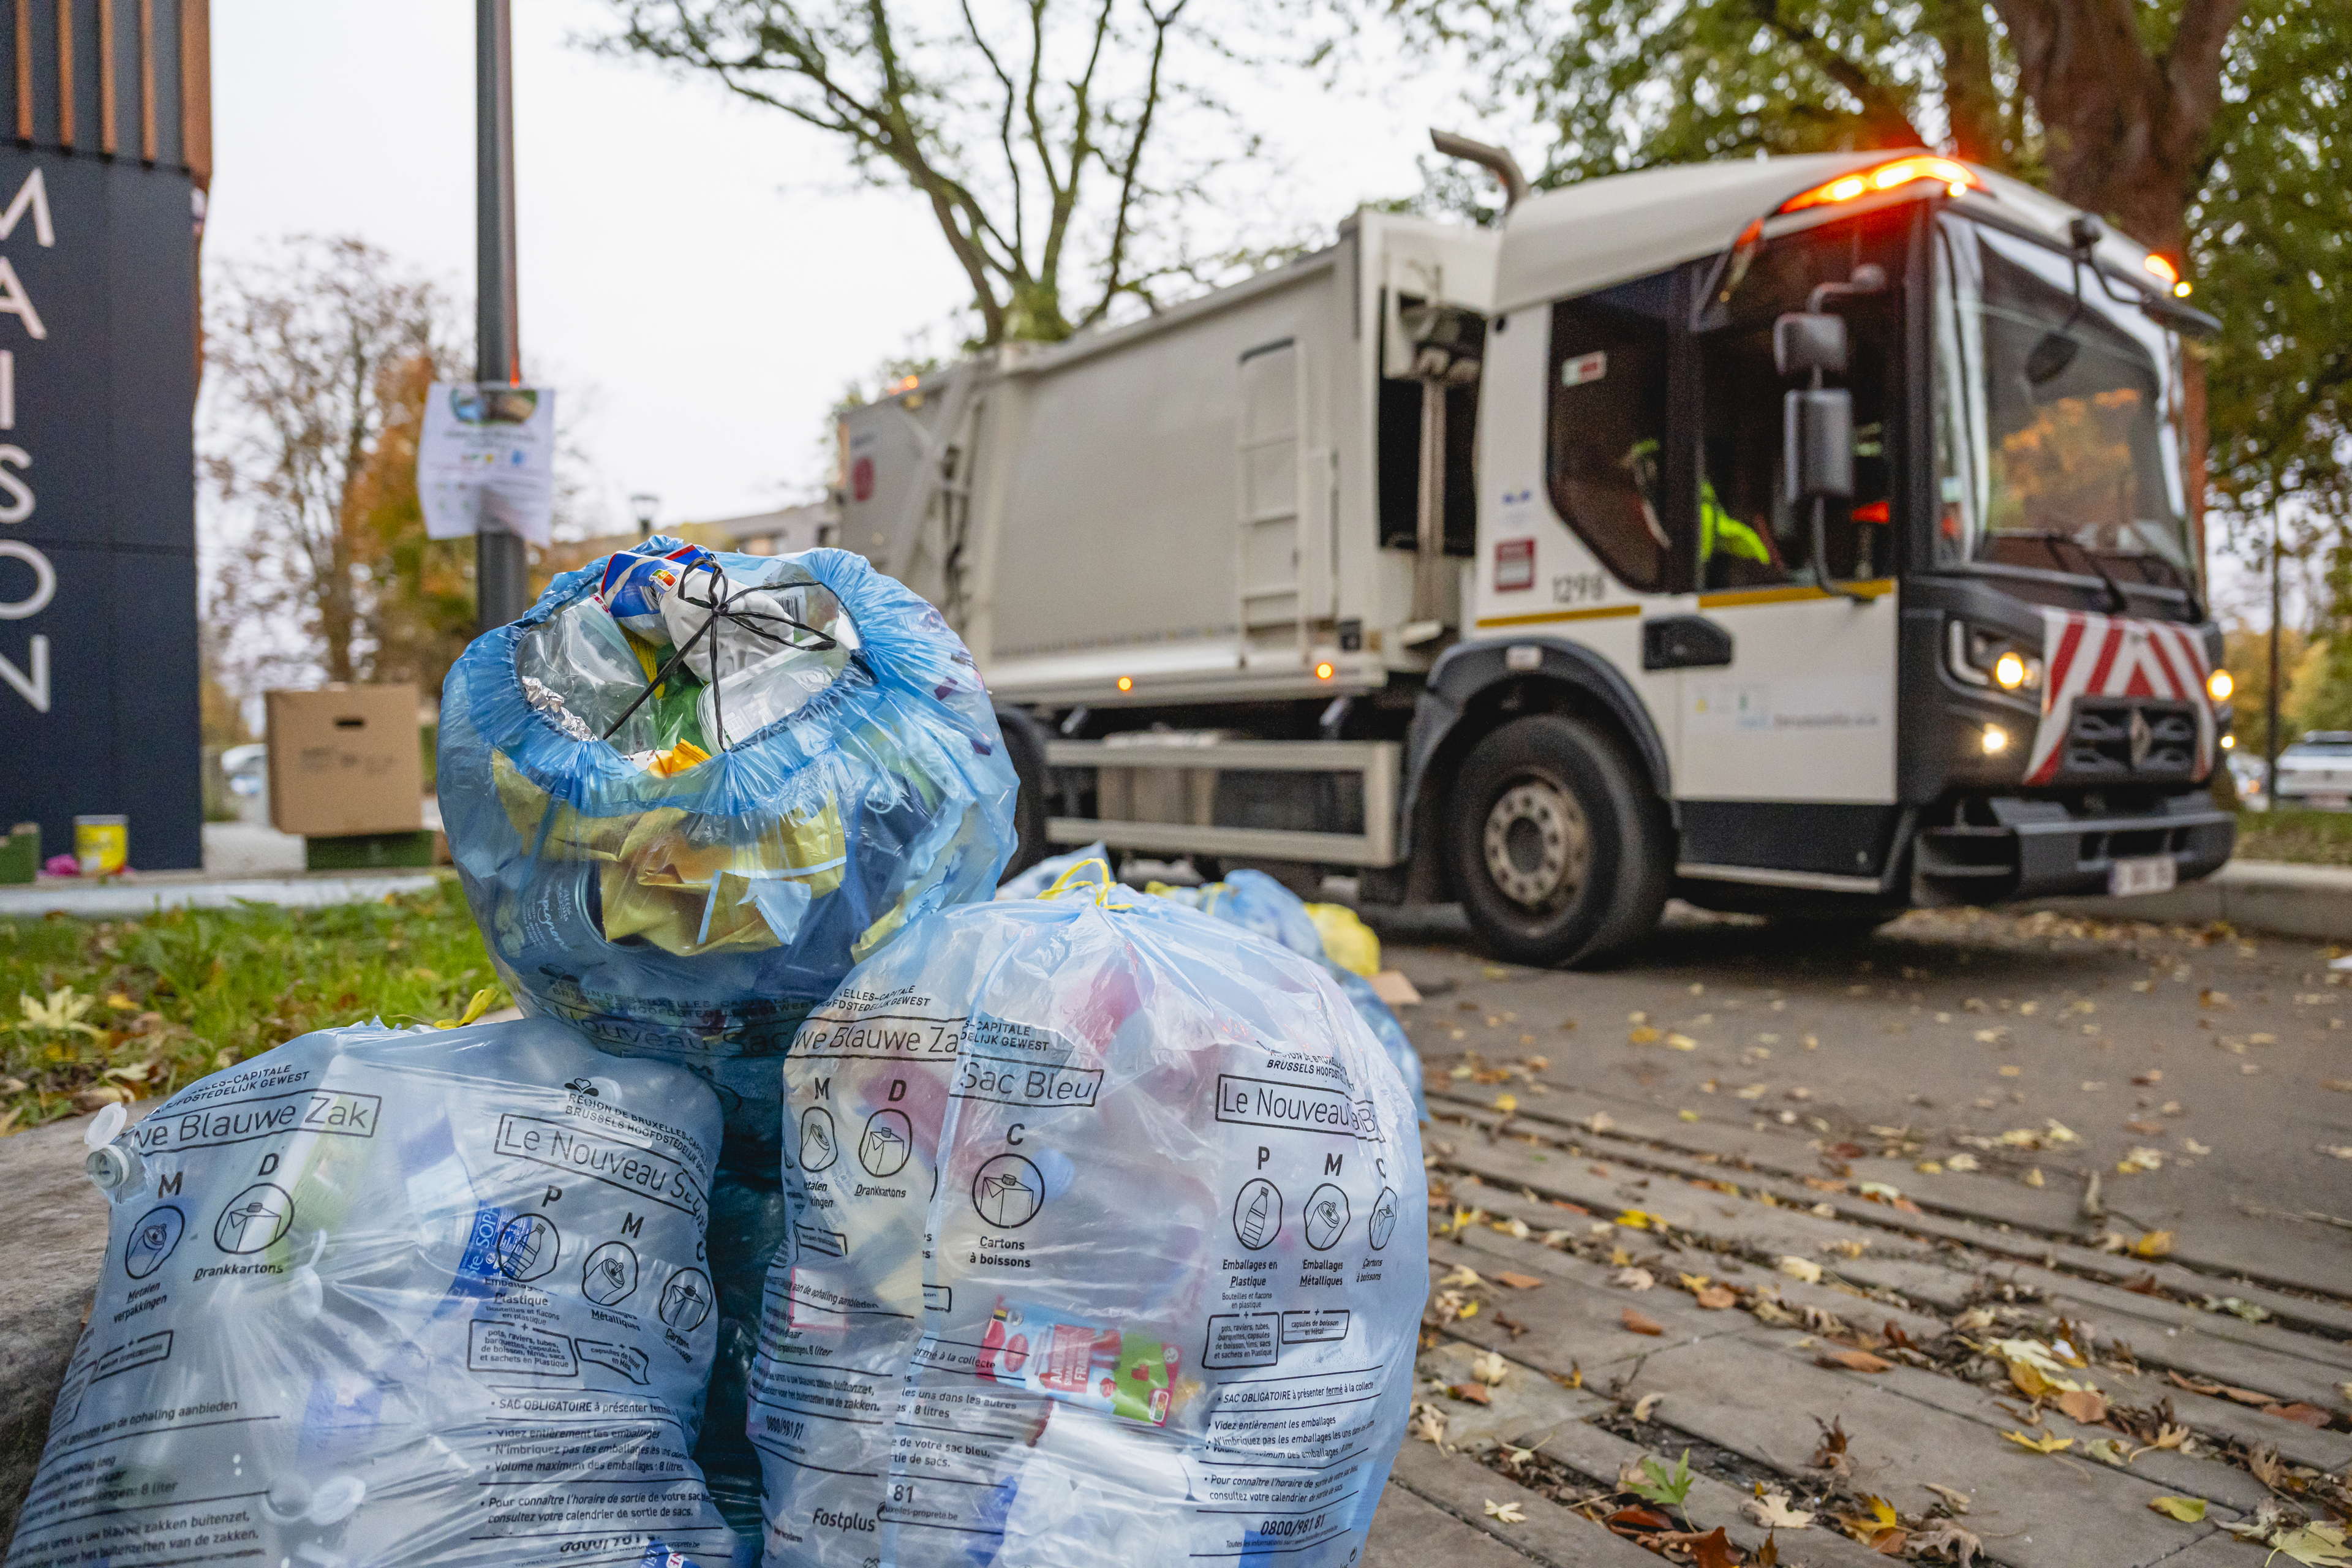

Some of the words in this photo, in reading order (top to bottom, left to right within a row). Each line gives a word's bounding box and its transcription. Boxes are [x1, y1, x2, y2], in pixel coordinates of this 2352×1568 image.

[840, 985, 916, 1001] ELLES-CAPITALE
[891, 996, 930, 1006] GEWEST
[829, 1025, 921, 1051] Blauwe
[928, 1027, 958, 1053] Za
[1002, 1038, 1050, 1051] GEWEST
[1267, 1059, 1314, 1074] BRUSSELS
[260, 1071, 310, 1088] GEWEST
[960, 1061, 1015, 1094] Sac
[1025, 1071, 1093, 1099] Bleu
[814, 1077, 829, 1101] M
[888, 1079, 907, 1102] D
[614, 1107, 629, 1118] DE
[1223, 1083, 1248, 1114] Le
[1257, 1087, 1349, 1126] Nouveau
[179, 1104, 296, 1142] Blauwe
[304, 1096, 369, 1130] Zak
[565, 1105, 625, 1129] BRUSSELS
[1006, 1123, 1025, 1147] C
[504, 1120, 540, 1152] Le
[551, 1130, 667, 1192] Nouveau
[1257, 1146, 1270, 1170] P
[258, 1153, 279, 1176] D
[1324, 1153, 1343, 1177] M
[157, 1171, 182, 1199] M
[854, 1183, 907, 1199] Drankkartons
[541, 1184, 563, 1208] P
[620, 1212, 645, 1239] M
[979, 1235, 1025, 1251] Cartons
[970, 1252, 976, 1264] à
[980, 1253, 1031, 1268] boissons
[1222, 1259, 1267, 1272] Emballages
[1268, 1260, 1278, 1270] en
[1302, 1259, 1343, 1272] Emballages
[1362, 1258, 1383, 1270] Cartons
[192, 1263, 284, 1281] Drankkartons
[1360, 1272, 1382, 1282] boissons
[1229, 1276, 1267, 1289] Plastique
[1298, 1274, 1343, 1287] Métalliques
[127, 1282, 161, 1303] Metalen
[494, 1292, 549, 1306] Plastique
[804, 1285, 810, 1295] de
[812, 1286, 838, 1305] ophaling
[839, 1296, 879, 1309] aanbieden
[1222, 1292, 1247, 1300] Bouteilles
[113, 1294, 167, 1324] verpakkingen
[1238, 1301, 1262, 1310] plastique
[514, 1313, 548, 1326] plastique
[590, 1308, 641, 1332] Métalliques
[1234, 1323, 1254, 1332] raviers,
[1291, 1320, 1311, 1329] capsules
[484, 1336, 527, 1350] barquettes,
[508, 1332, 535, 1345] raviers,
[537, 1340, 559, 1349] tubes,
[815, 1346, 833, 1357] liter
[939, 1350, 945, 1360] à
[947, 1352, 956, 1362] la
[958, 1354, 995, 1368] collecte
[1251, 1349, 1272, 1358] Plastique
[490, 1354, 521, 1363] sachets
[534, 1357, 570, 1368] Plastique
[902, 1387, 916, 1397] les
[919, 1390, 936, 1400] uns
[940, 1392, 963, 1403] dans
[966, 1393, 981, 1404] les
[984, 1398, 1017, 1409] autres
[1223, 1394, 1240, 1403] SAC
[1242, 1390, 1291, 1403] OBLIGATOIRE
[1292, 1391, 1296, 1400] à
[1297, 1387, 1324, 1400] présenter
[1325, 1384, 1343, 1396] fermé
[1349, 1382, 1354, 1392] la
[1355, 1381, 1373, 1392] collecte
[499, 1398, 521, 1410] SAC
[524, 1400, 593, 1412] OBLIGATOIRE
[594, 1401, 600, 1412] à
[602, 1401, 648, 1414] présenter
[835, 1397, 843, 1408] de
[843, 1399, 881, 1411] zakken.
[923, 1405, 949, 1418] litres
[129, 1409, 175, 1425] ophaling
[178, 1400, 238, 1417] aanbieden
[1215, 1420, 1236, 1430] Videz
[1238, 1419, 1286, 1430] entièrement
[1288, 1419, 1300, 1428] les
[1301, 1415, 1336, 1428] emballages
[529, 1427, 592, 1439] entièrement
[1262, 1437, 1276, 1446] pas
[1278, 1434, 1289, 1444] les
[1291, 1431, 1332, 1444] emballages
[1332, 1430, 1341, 1440] les
[495, 1443, 560, 1456] N'imbriquez
[562, 1446, 580, 1457] pas
[582, 1444, 597, 1454] les
[598, 1443, 650, 1456] emballages
[900, 1437, 911, 1447] de
[915, 1439, 942, 1450] votre
[945, 1444, 962, 1453] sac
[910, 1453, 921, 1464] de
[925, 1457, 951, 1468] sacs.
[1287, 1450, 1300, 1459] des
[1302, 1447, 1339, 1460] emballages
[494, 1461, 534, 1472] Volume
[535, 1461, 585, 1471] maximum
[587, 1460, 605, 1470] des
[607, 1461, 654, 1473] emballages
[666, 1461, 684, 1472] litres
[153, 1481, 178, 1494] liter
[1210, 1474, 1231, 1485] Pour
[1232, 1476, 1270, 1487] connaître
[1270, 1477, 1303, 1488] l'horaire
[1304, 1479, 1313, 1488] de
[488, 1496, 514, 1508] Pour
[518, 1494, 565, 1506] connaître
[566, 1493, 605, 1506] l'horaire
[607, 1493, 619, 1504] de
[619, 1491, 646, 1504] sortie
[648, 1492, 659, 1502] de
[661, 1491, 686, 1502] votre
[688, 1492, 700, 1501] sac
[893, 1485, 914, 1504] 81
[1209, 1490, 1248, 1501] consultez
[1250, 1493, 1270, 1502] votre
[1271, 1491, 1308, 1502] calendrier
[145, 1518, 187, 1534] zakken
[190, 1510, 250, 1528] buitenzet,
[488, 1512, 536, 1524] consultez
[537, 1511, 564, 1522] votre
[565, 1509, 614, 1521] calendrier
[616, 1509, 628, 1518] de
[631, 1506, 658, 1518] sortie
[660, 1506, 671, 1517] de
[672, 1507, 693, 1517] sacs.
[812, 1507, 875, 1532] Fostplus
[1261, 1514, 1313, 1537] 0800/981
[1314, 1513, 1326, 1529] 81
[169, 1537, 192, 1549] van
[195, 1534, 210, 1547] de
[213, 1529, 259, 1544] zakken.
[1225, 1540, 1243, 1548] Toutes
[1251, 1538, 1284, 1547] informations
